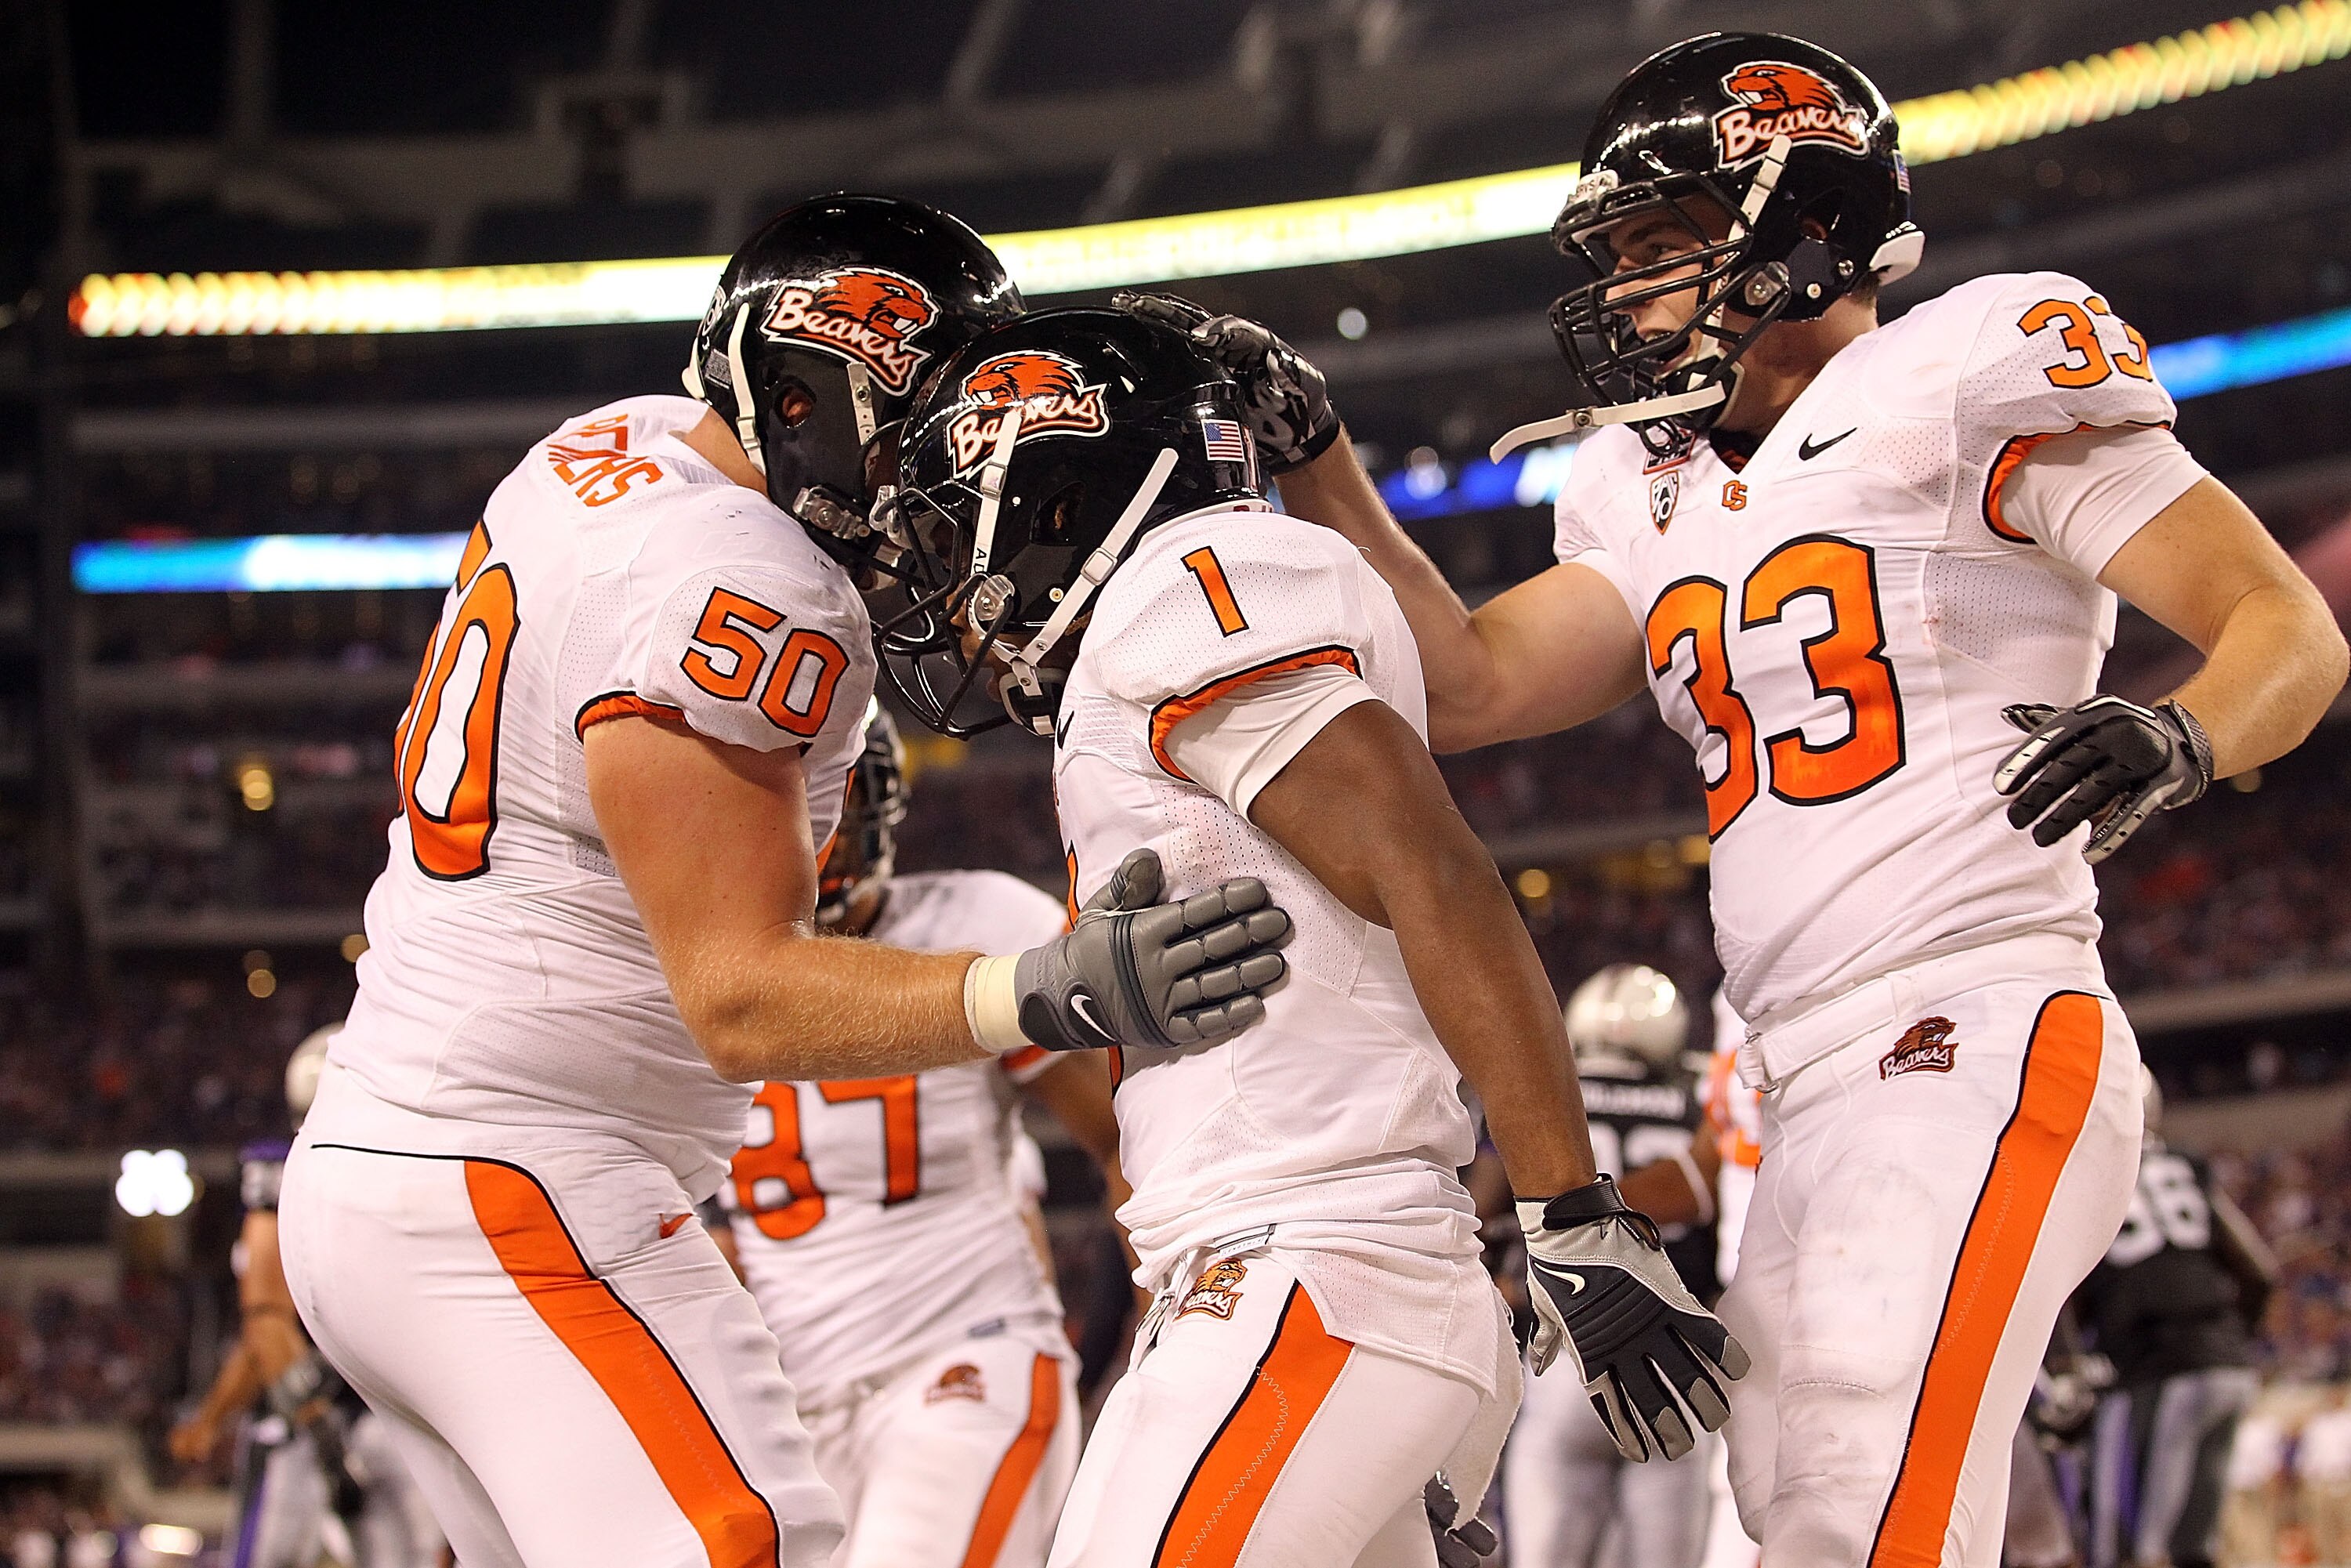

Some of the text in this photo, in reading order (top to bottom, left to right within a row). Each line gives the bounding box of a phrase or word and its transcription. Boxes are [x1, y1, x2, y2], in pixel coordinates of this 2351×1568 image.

[769, 289, 921, 388] Beavers
[2016, 295, 2153, 389] 33
[1180, 545, 1250, 638] 1
[680, 586, 849, 738] 50
[1646, 533, 1905, 845] 33
[1882, 1046, 1951, 1080] Beavers
[732, 1078, 920, 1240] 87
[1185, 1289, 1234, 1320] eavers
